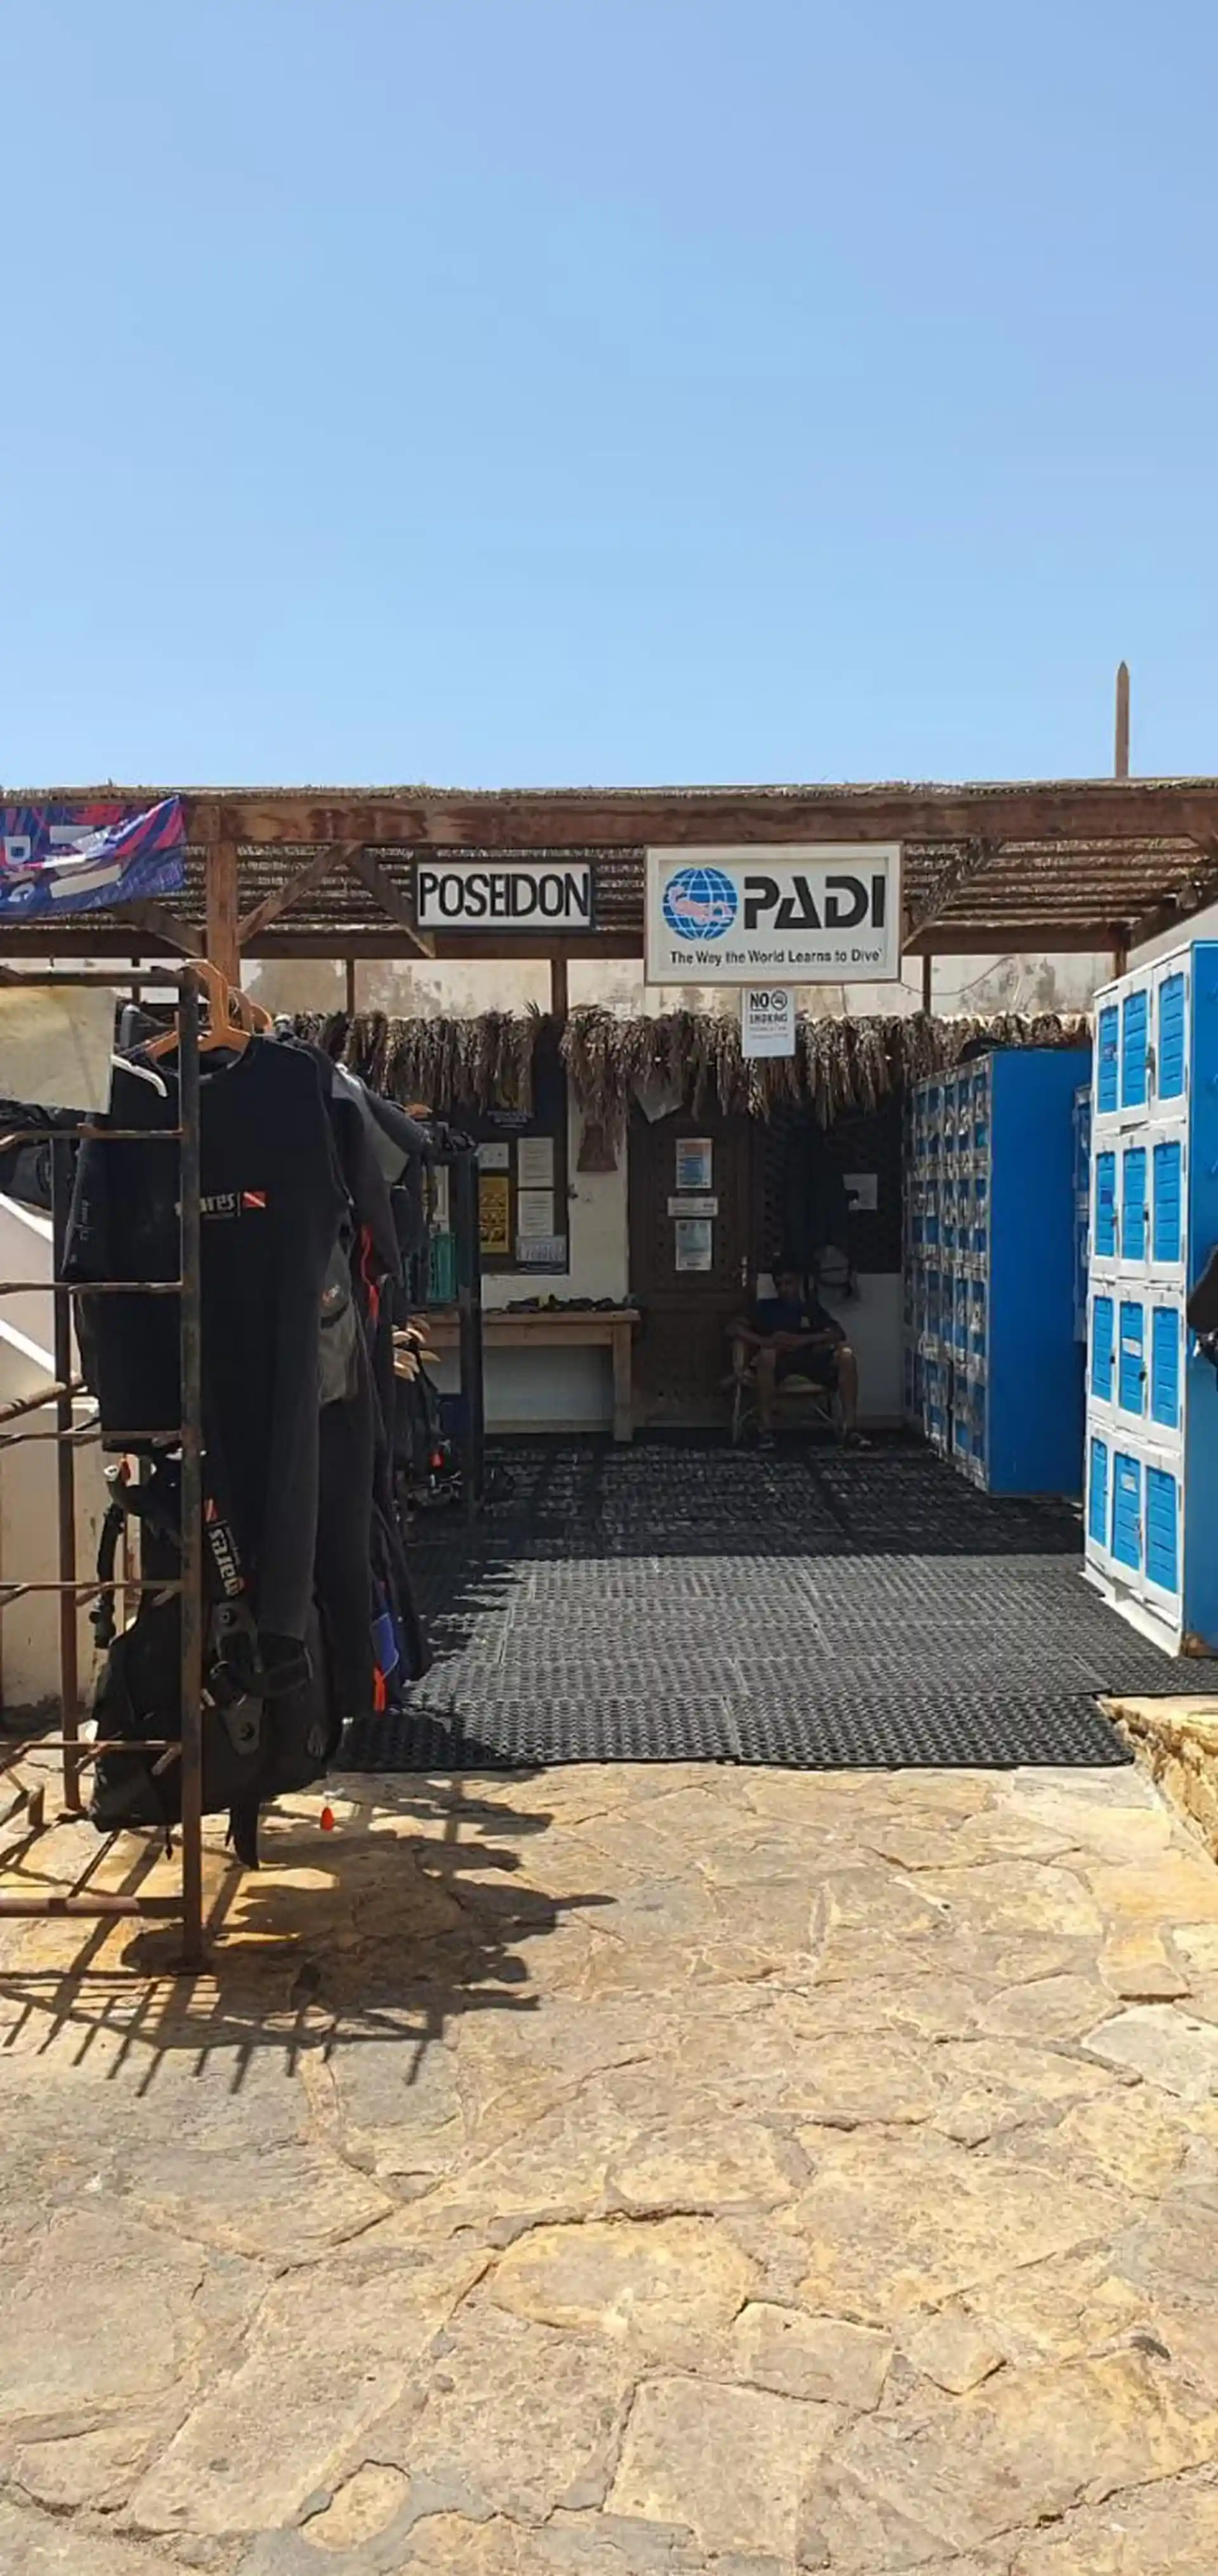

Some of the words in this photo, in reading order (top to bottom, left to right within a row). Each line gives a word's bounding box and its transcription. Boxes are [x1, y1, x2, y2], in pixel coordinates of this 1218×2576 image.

[419, 872, 589, 917] POSEIDON
[744, 875, 885, 930] PADI
[671, 951, 693, 964] The
[695, 950, 722, 967] Way
[725, 951, 746, 964] the
[747, 949, 784, 964] World
[788, 950, 832, 963] Learns
[834, 950, 847, 963] to
[750, 992, 769, 1008] NO
